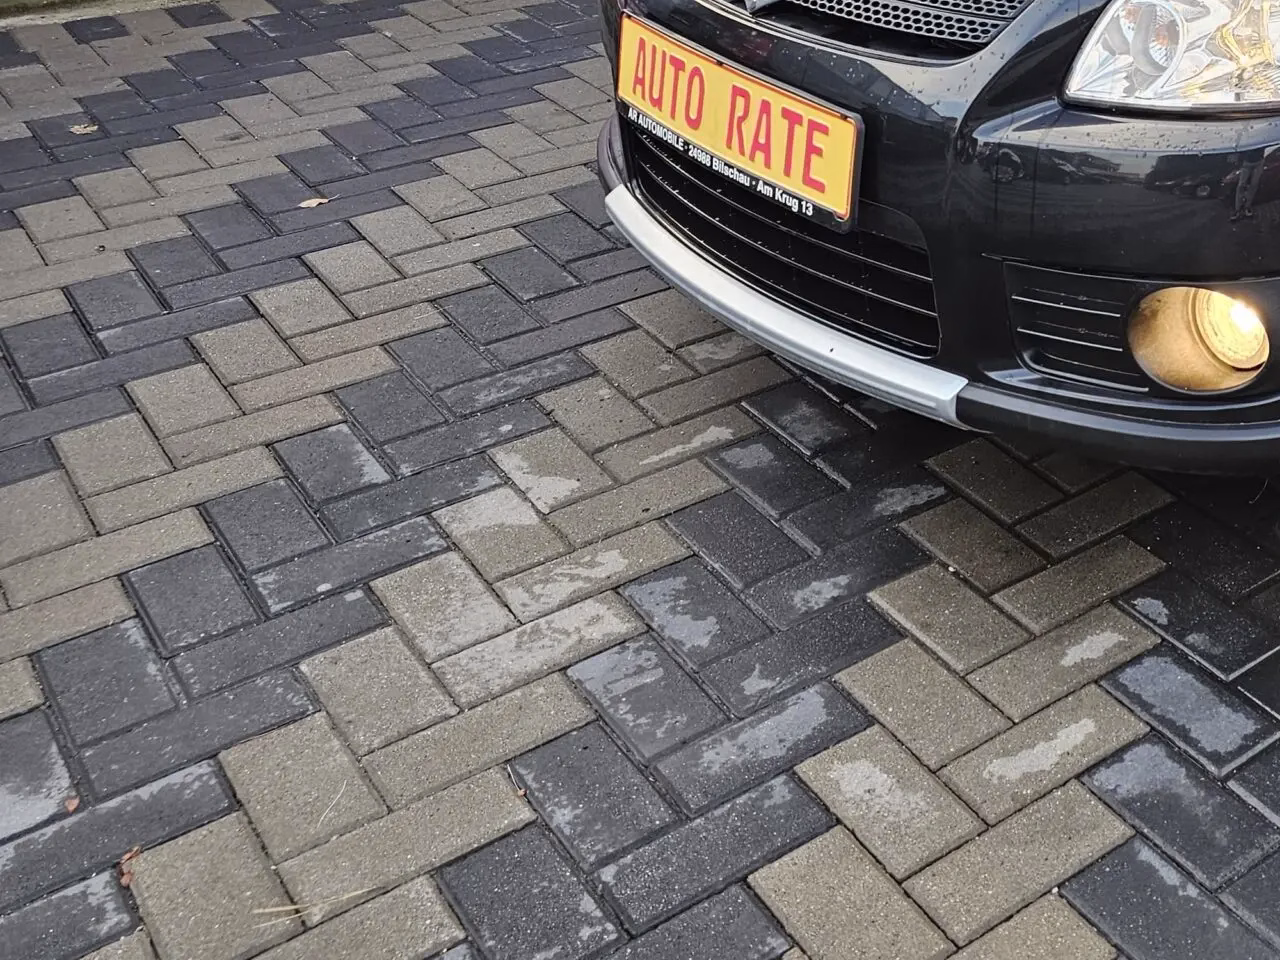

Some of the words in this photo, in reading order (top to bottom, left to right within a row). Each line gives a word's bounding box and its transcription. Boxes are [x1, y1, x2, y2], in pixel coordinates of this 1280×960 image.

[628, 107, 638, 122] AR
[638, 113, 684, 151] AUTOMOBILE
[712, 157, 751, 186] Bilschau
[756, 180, 773, 198] Am
[775, 187, 799, 212] Krug
[801, 200, 814, 216] 13
[632, 36, 706, 131] AUTO
[725, 83, 830, 194] RATE
